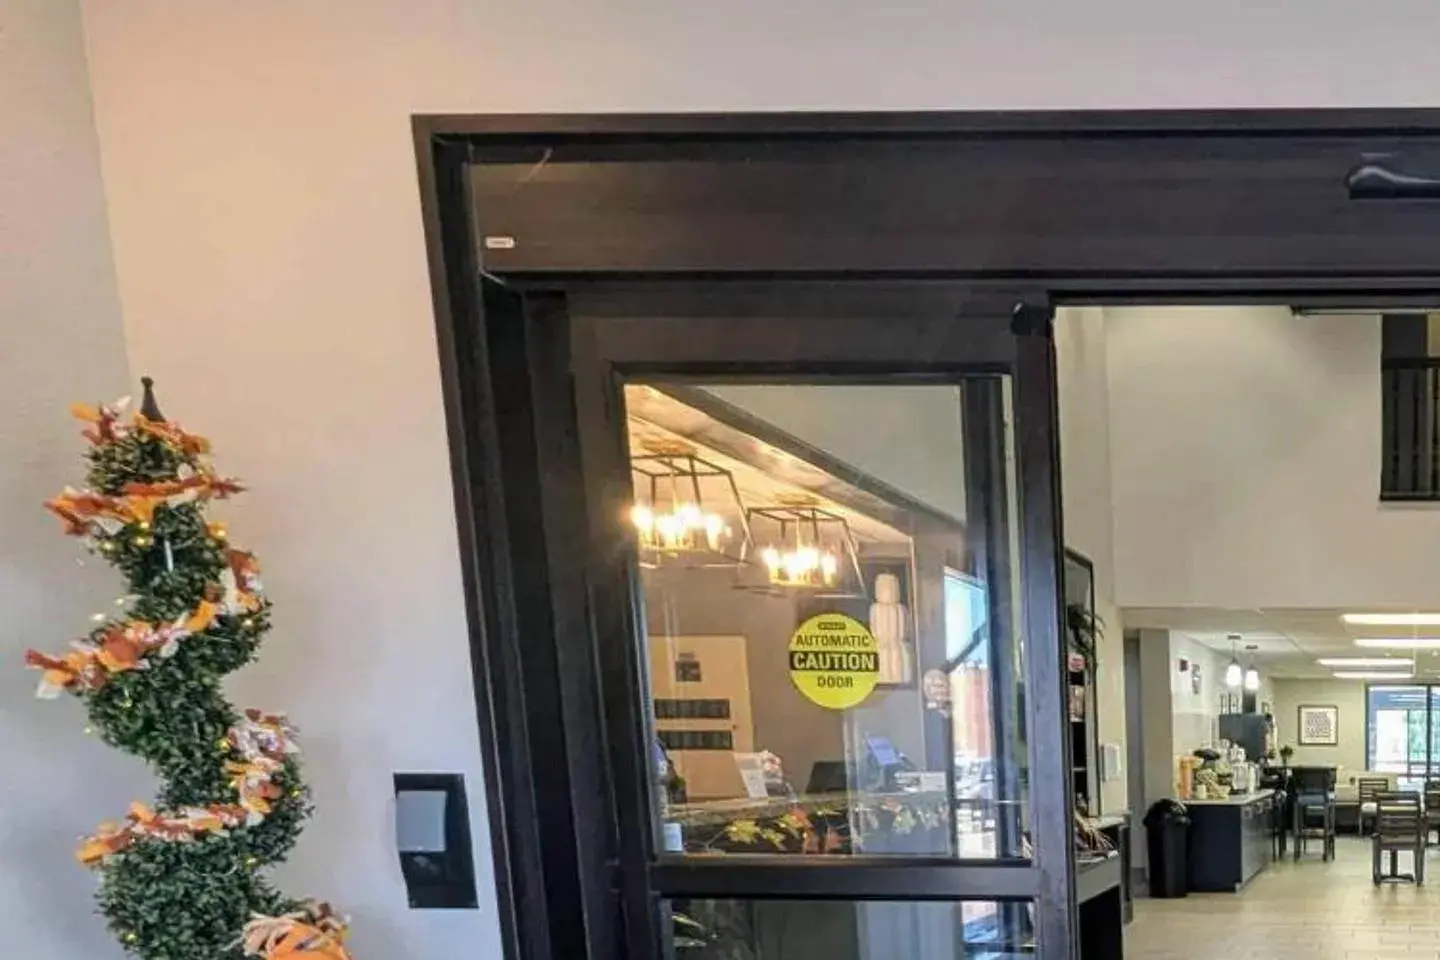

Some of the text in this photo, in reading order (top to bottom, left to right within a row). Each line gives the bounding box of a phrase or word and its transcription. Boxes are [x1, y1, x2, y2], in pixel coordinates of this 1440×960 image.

[796, 635, 870, 646] AUTOMATIC
[793, 652, 875, 670] CAUTION
[817, 676, 854, 688] DOOR
